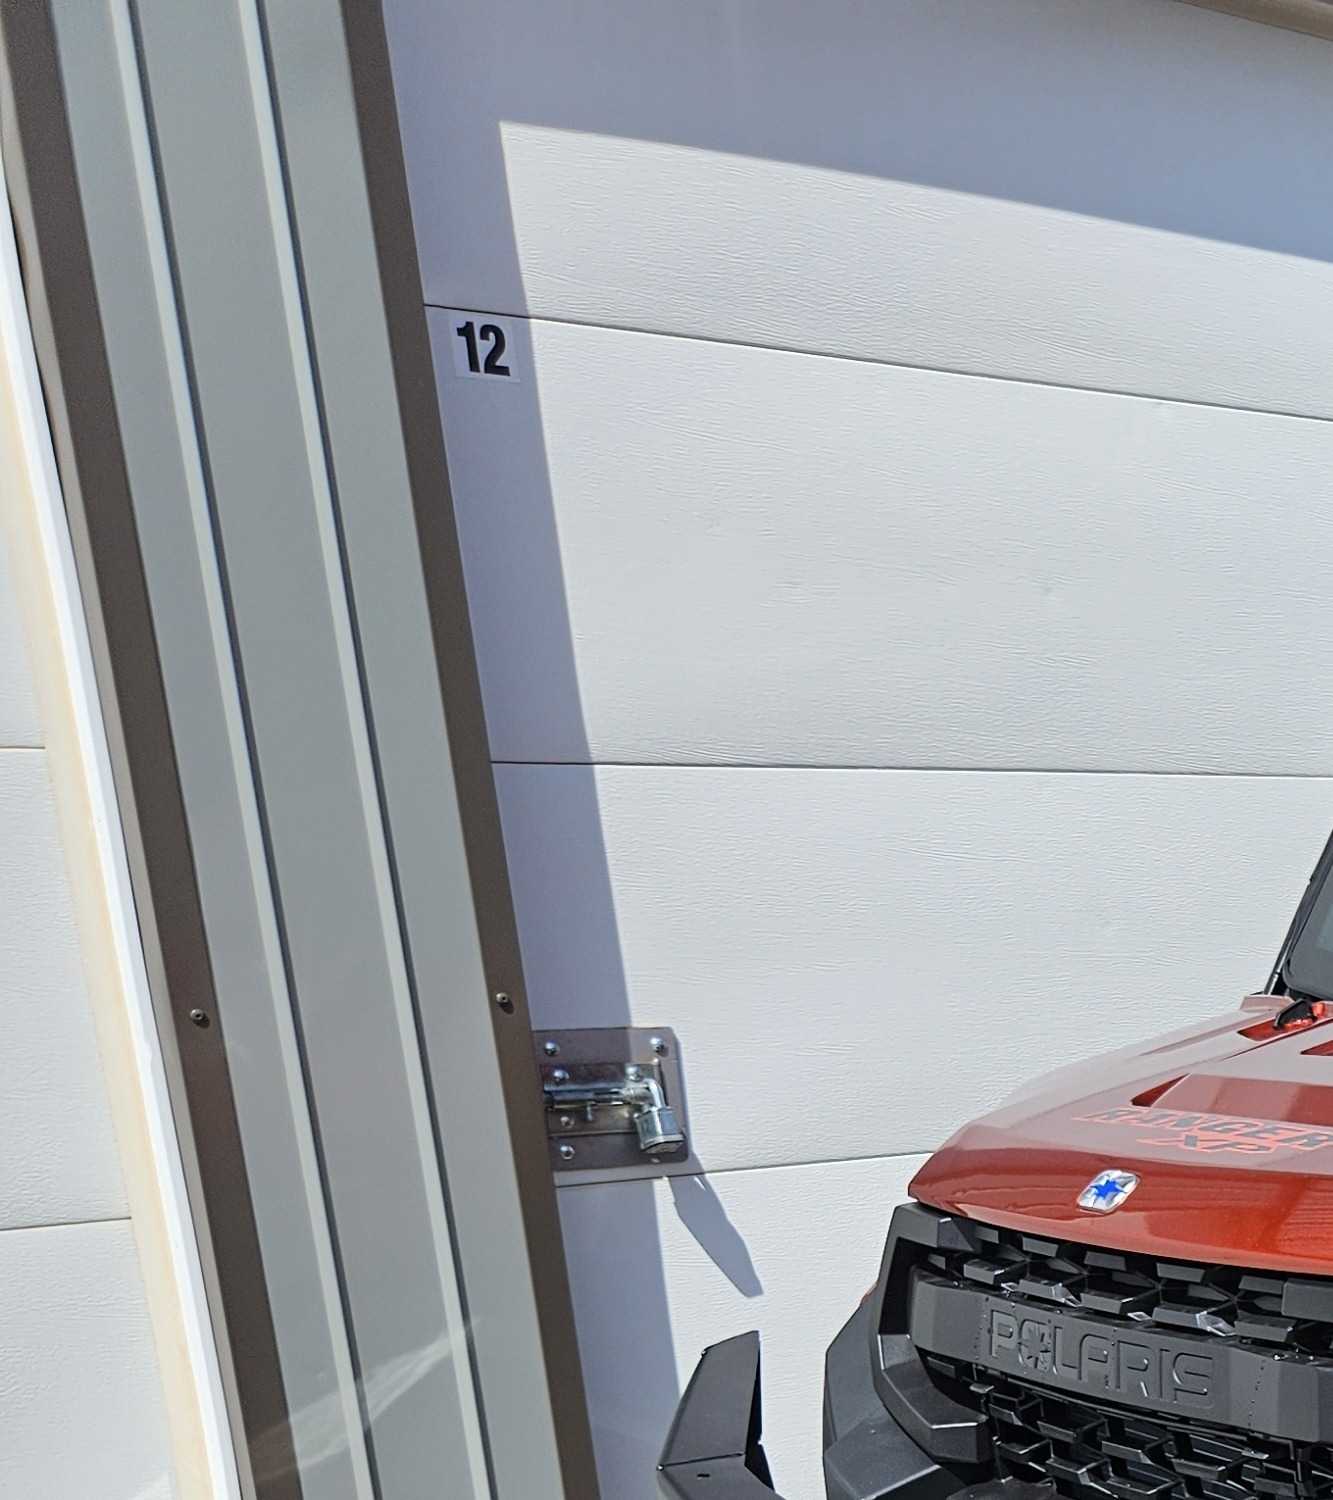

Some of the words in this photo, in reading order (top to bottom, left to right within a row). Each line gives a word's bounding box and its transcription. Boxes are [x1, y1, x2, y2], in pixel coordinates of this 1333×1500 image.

[456, 321, 511, 377] 12
[1137, 1132, 1275, 1154] XP
[988, 1308, 1218, 1409] POLARIS
